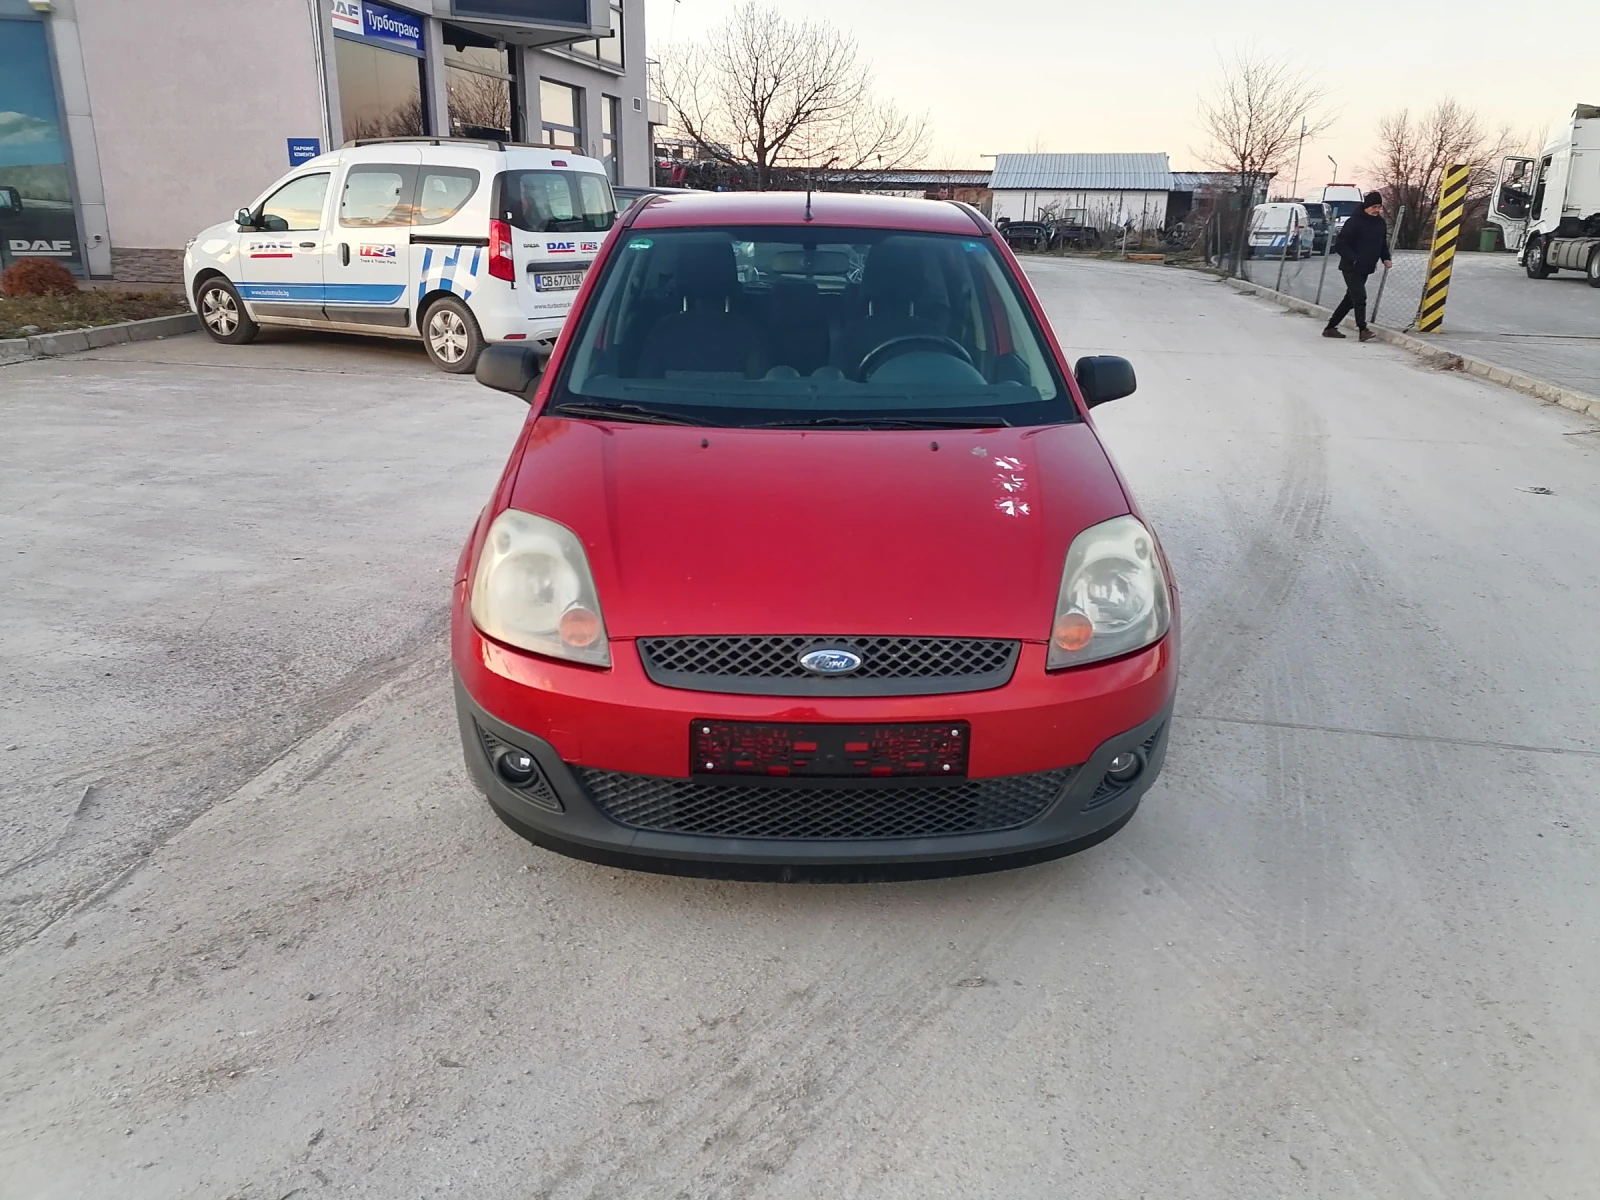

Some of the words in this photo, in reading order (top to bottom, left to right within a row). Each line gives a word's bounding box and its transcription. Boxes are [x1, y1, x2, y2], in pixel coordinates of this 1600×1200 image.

[332, 0, 358, 16] AF
[366, 9, 419, 38] Турботракс
[9, 240, 71, 250] DAF
[250, 242, 292, 252] DAF
[360, 244, 395, 257] TRP
[547, 242, 575, 250] DAF
[541, 276, 553, 287] CB
[553, 274, 572, 286] 6770
[814, 654, 848, 668] Ford
